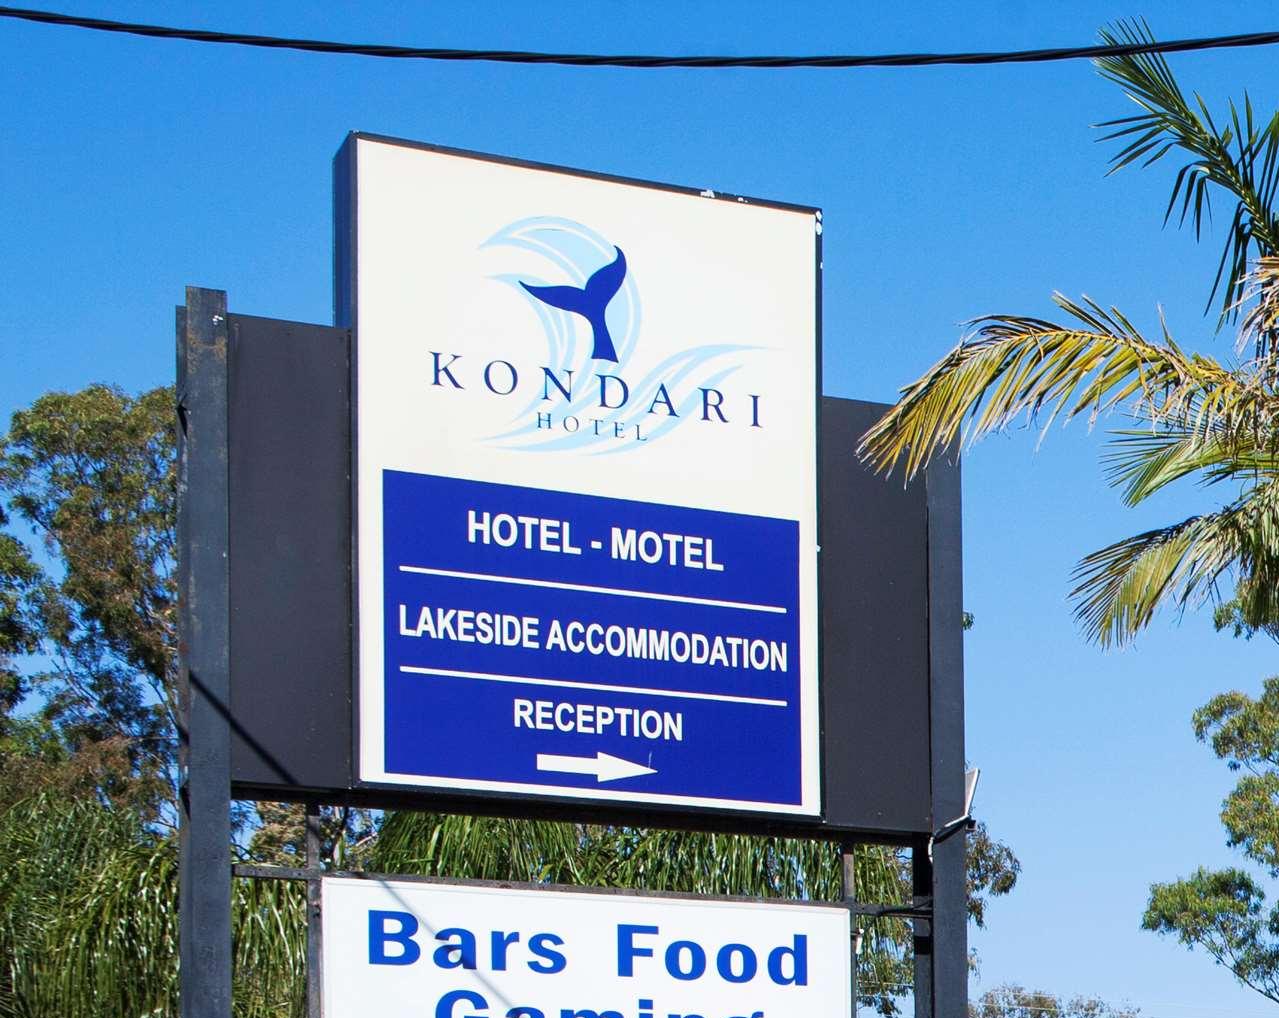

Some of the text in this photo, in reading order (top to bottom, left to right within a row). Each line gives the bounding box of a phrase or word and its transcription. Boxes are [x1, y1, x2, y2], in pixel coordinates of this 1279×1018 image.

[430, 350, 763, 428] KONDARI
[536, 412, 648, 441] HOTEL
[467, 510, 581, 555] HOTEL
[610, 527, 724, 571] MOTEL
[399, 605, 787, 672] LAKESIDE ACCOMMODATION
[513, 699, 683, 741] RECEPTION
[367, 909, 808, 986] Bars Food
